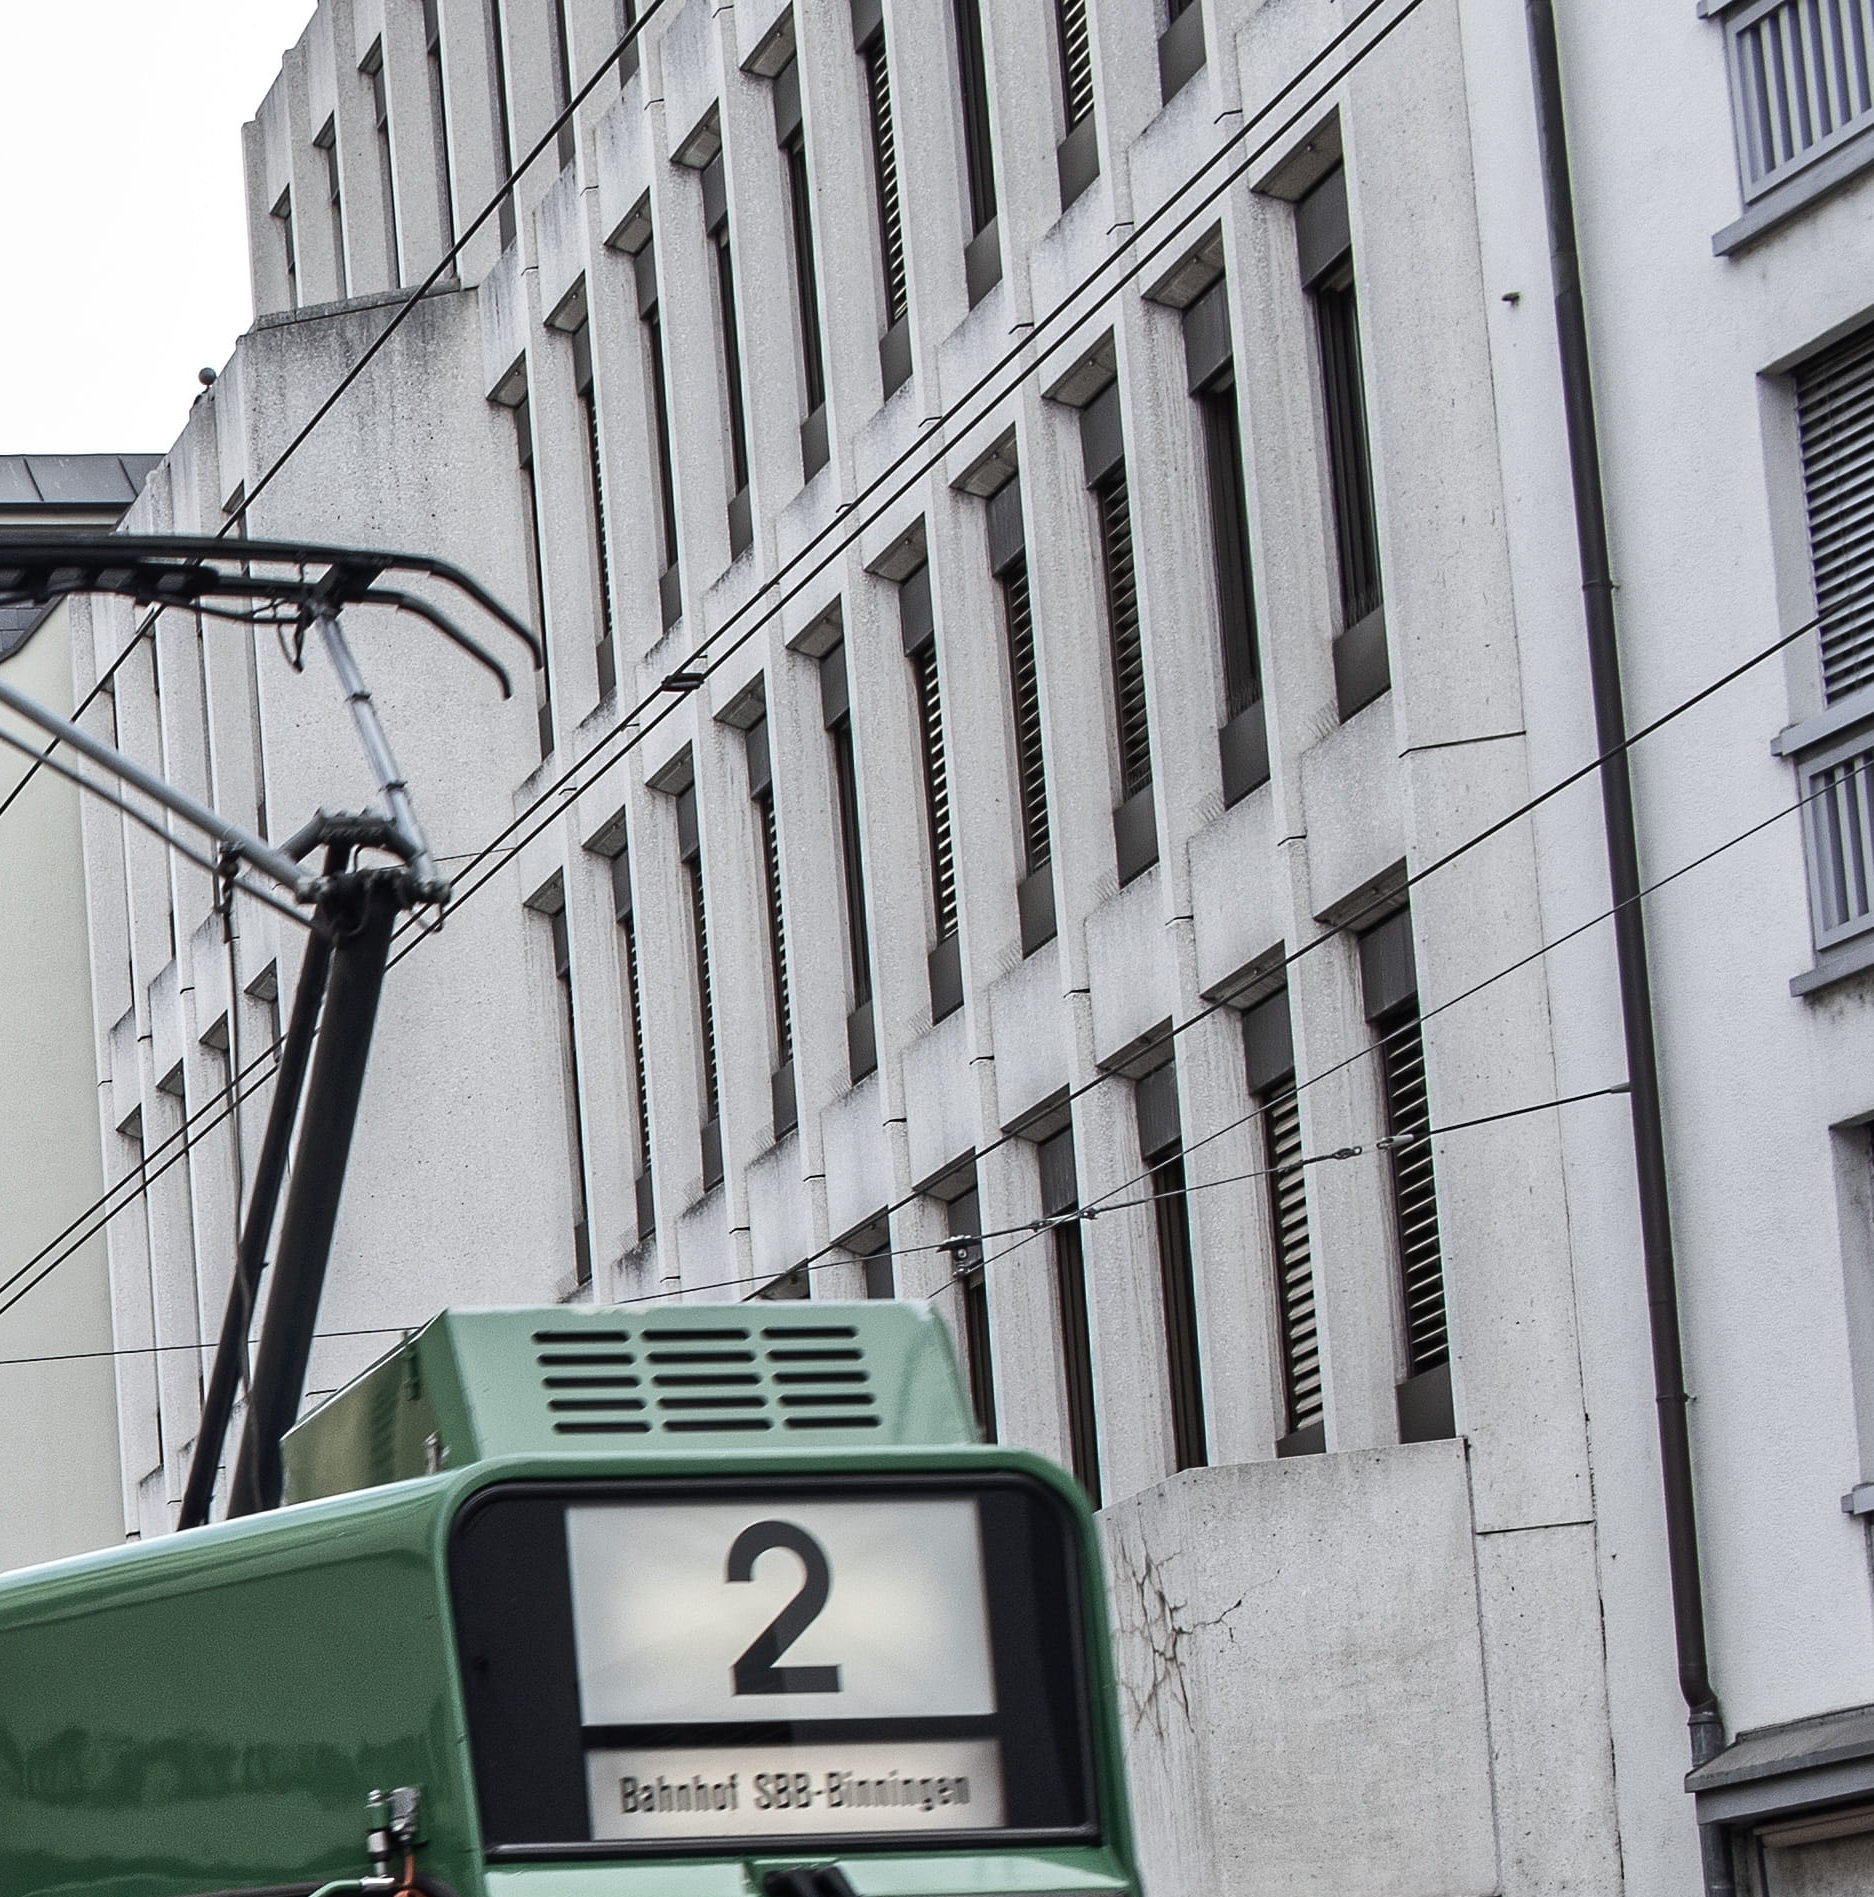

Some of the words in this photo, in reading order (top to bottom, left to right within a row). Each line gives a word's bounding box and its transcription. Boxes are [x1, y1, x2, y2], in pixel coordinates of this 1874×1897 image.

[725, 1520, 840, 1695] 2
[618, 1774, 740, 1815] Bahnhof
[752, 1769, 971, 1811] SBB-Binningen
